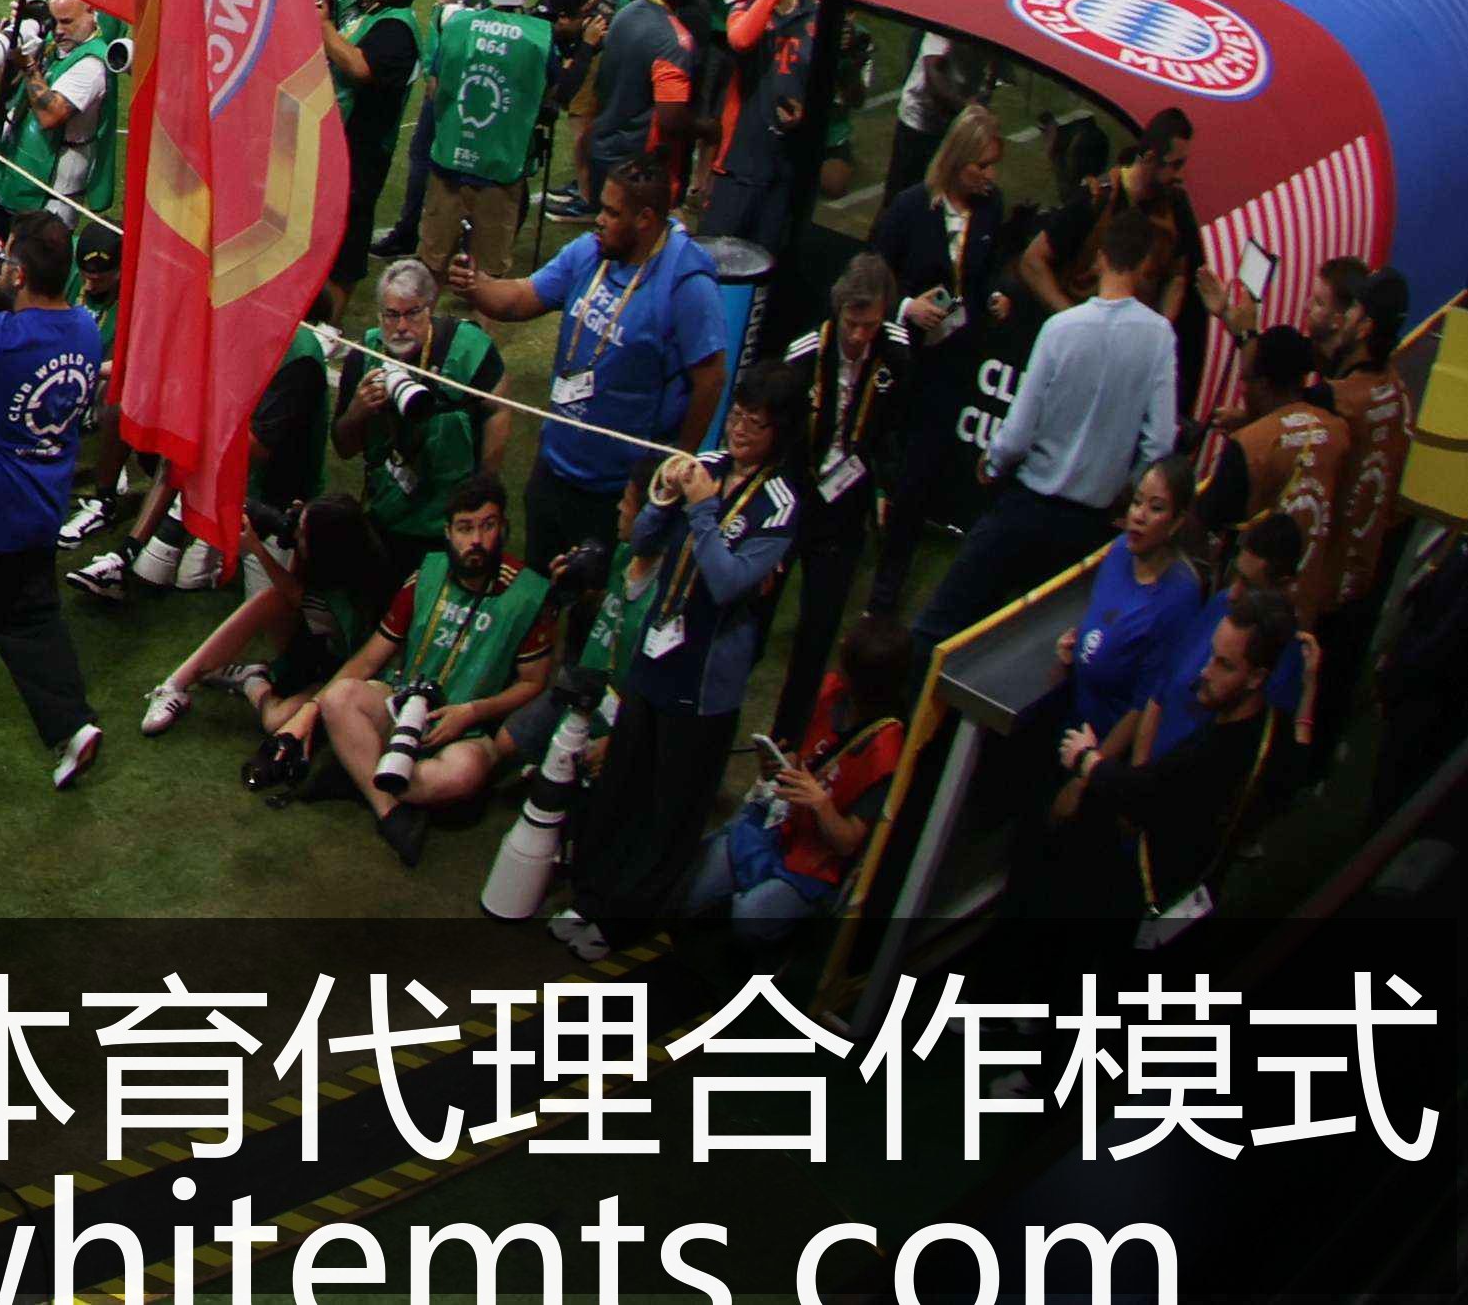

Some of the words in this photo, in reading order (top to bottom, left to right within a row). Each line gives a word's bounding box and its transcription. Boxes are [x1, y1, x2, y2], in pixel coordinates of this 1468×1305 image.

[470, 19, 523, 41] PHOTO
[1029, 5, 1079, 36] FC
[1119, 14, 1258, 89] MÜNCHEN
[7, 382, 33, 422] CLUB
[35, 352, 85, 383] WORLD
